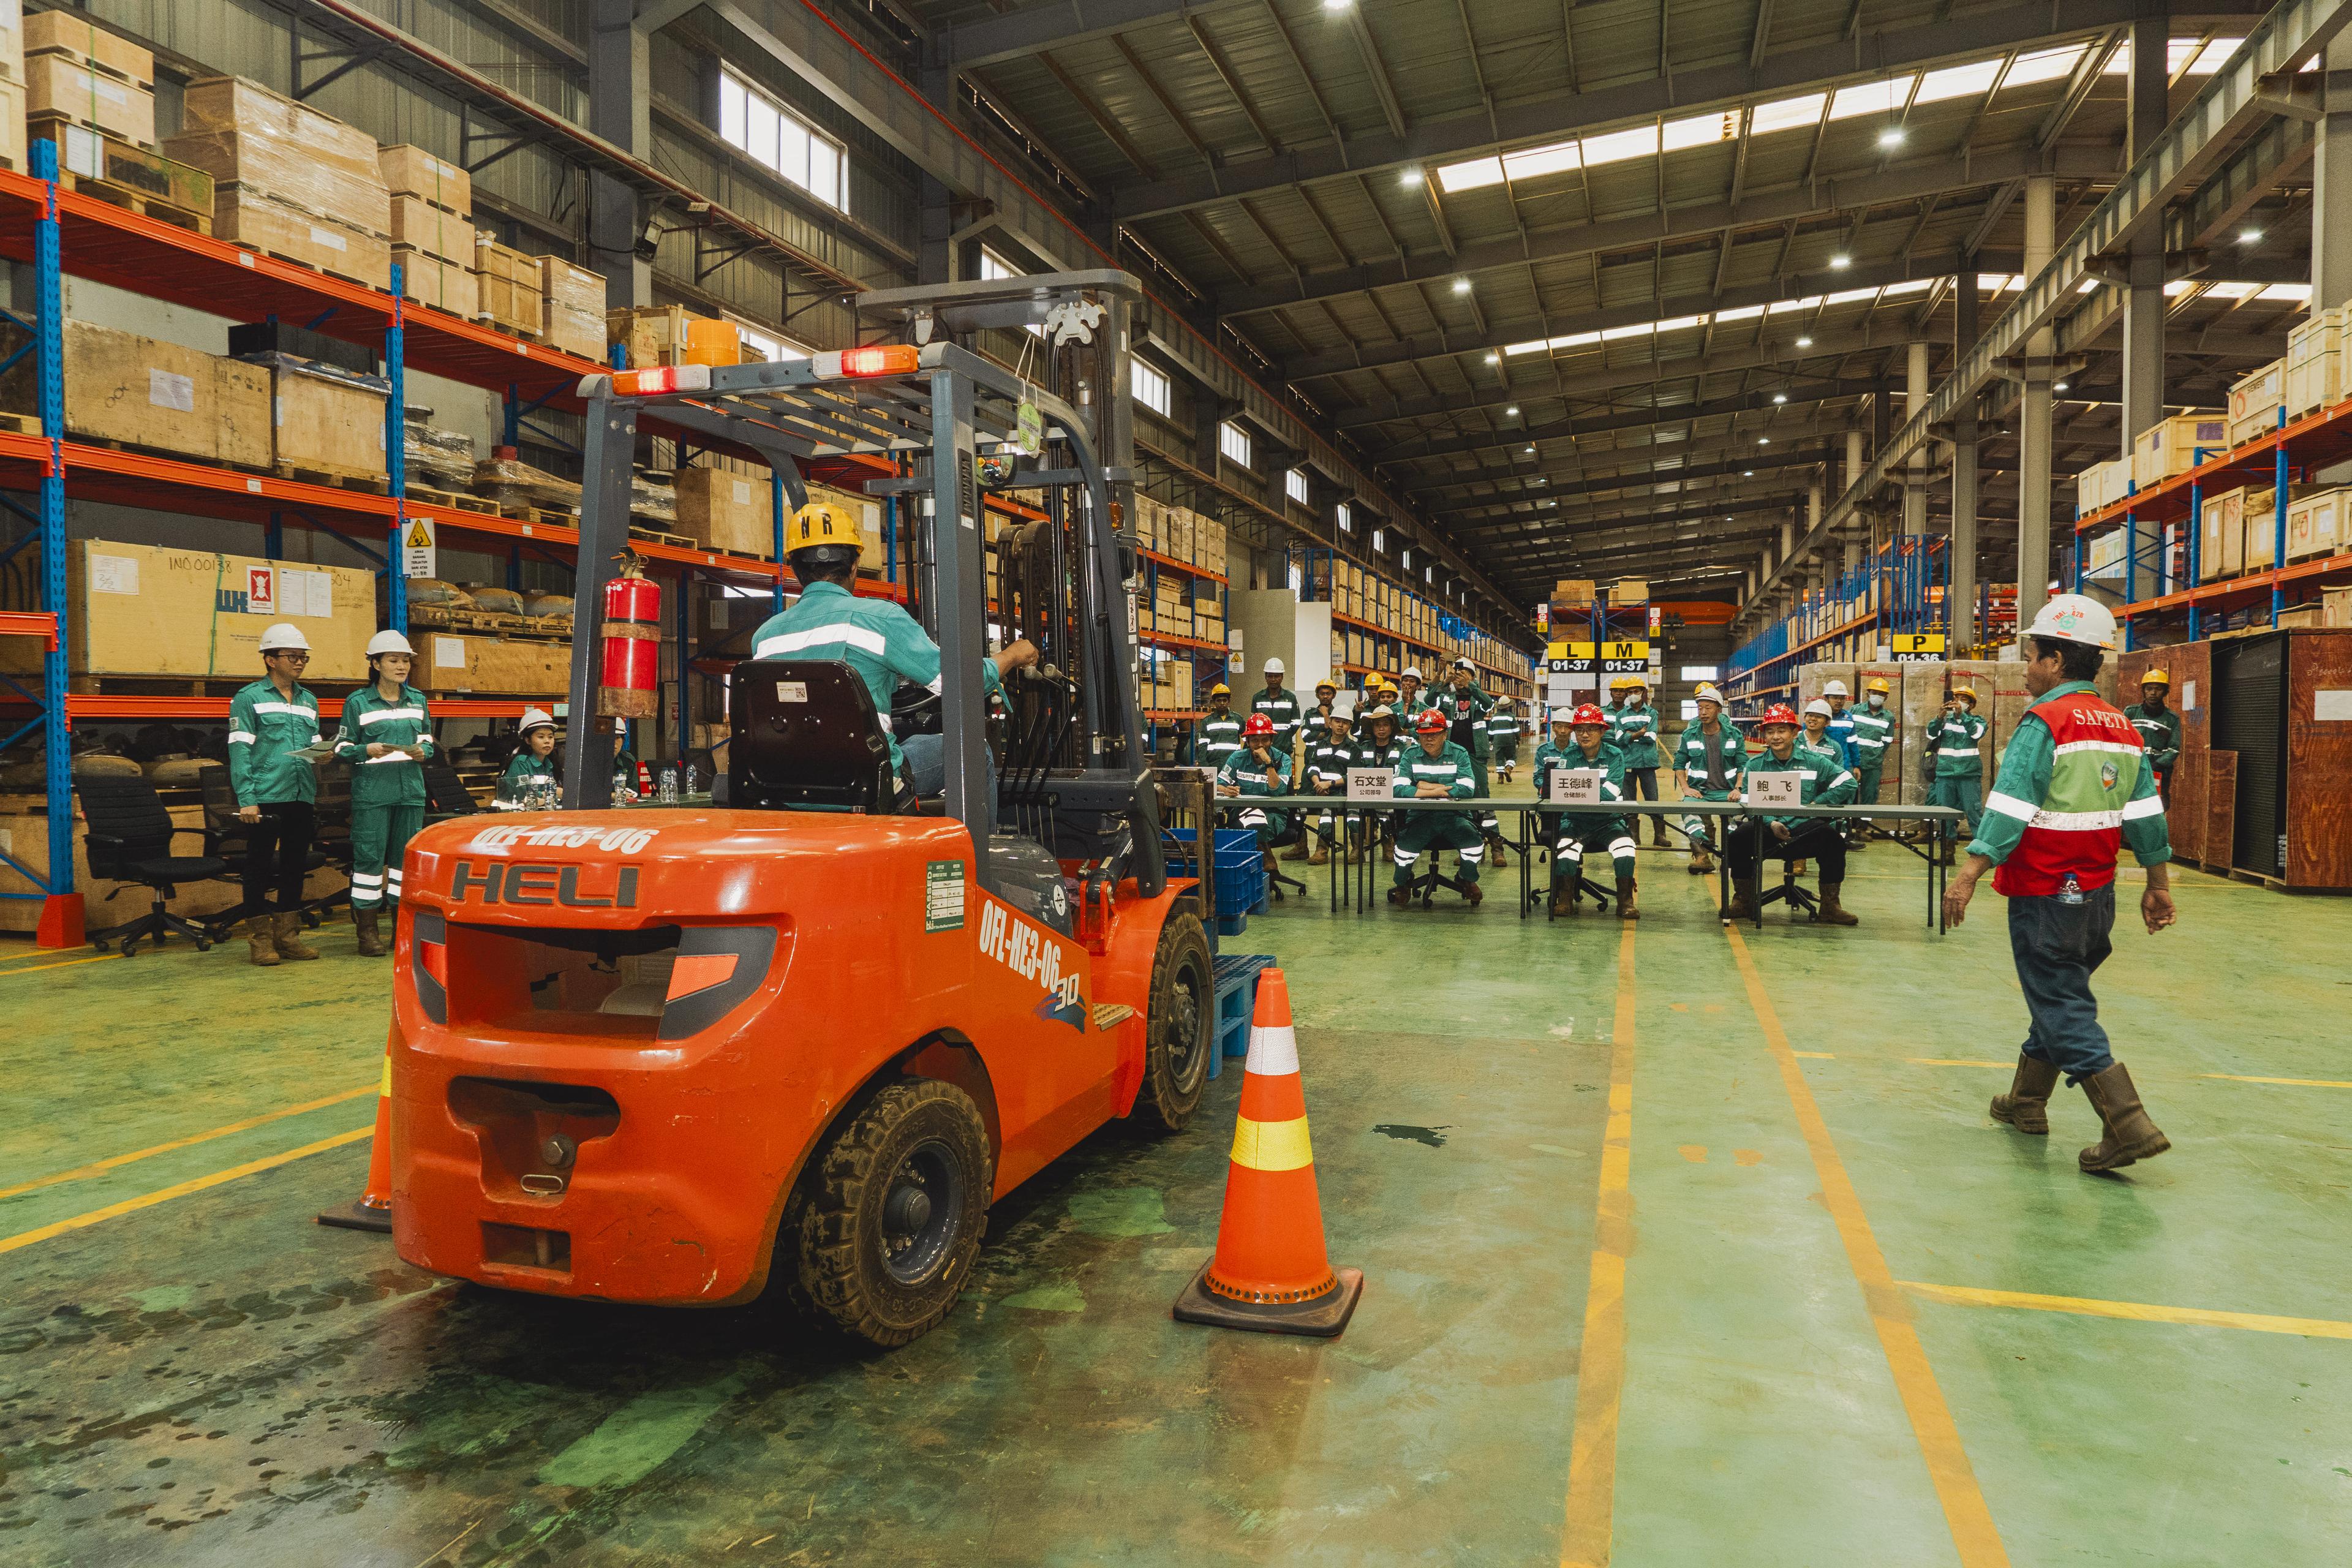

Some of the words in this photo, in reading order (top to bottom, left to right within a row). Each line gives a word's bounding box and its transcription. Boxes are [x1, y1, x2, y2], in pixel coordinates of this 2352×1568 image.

[801, 515, 810, 539] N
[822, 513, 832, 535] R
[1616, 643, 1632, 657] M
[1912, 635, 1926, 650] P
[1567, 644, 1578, 657] L
[1552, 660, 1591, 671] 01-37
[1605, 660, 1644, 671] 01-37
[2072, 709, 2129, 730] SAFETY
[1354, 775, 1387, 786] 石文堂
[1558, 778, 1593, 789] 王德峰
[470, 825, 660, 854] OFL-HE3-06
[450, 861, 639, 908] HELI
[980, 899, 1061, 993] OFL-HE3-06
[1054, 973, 1079, 1012] 30
